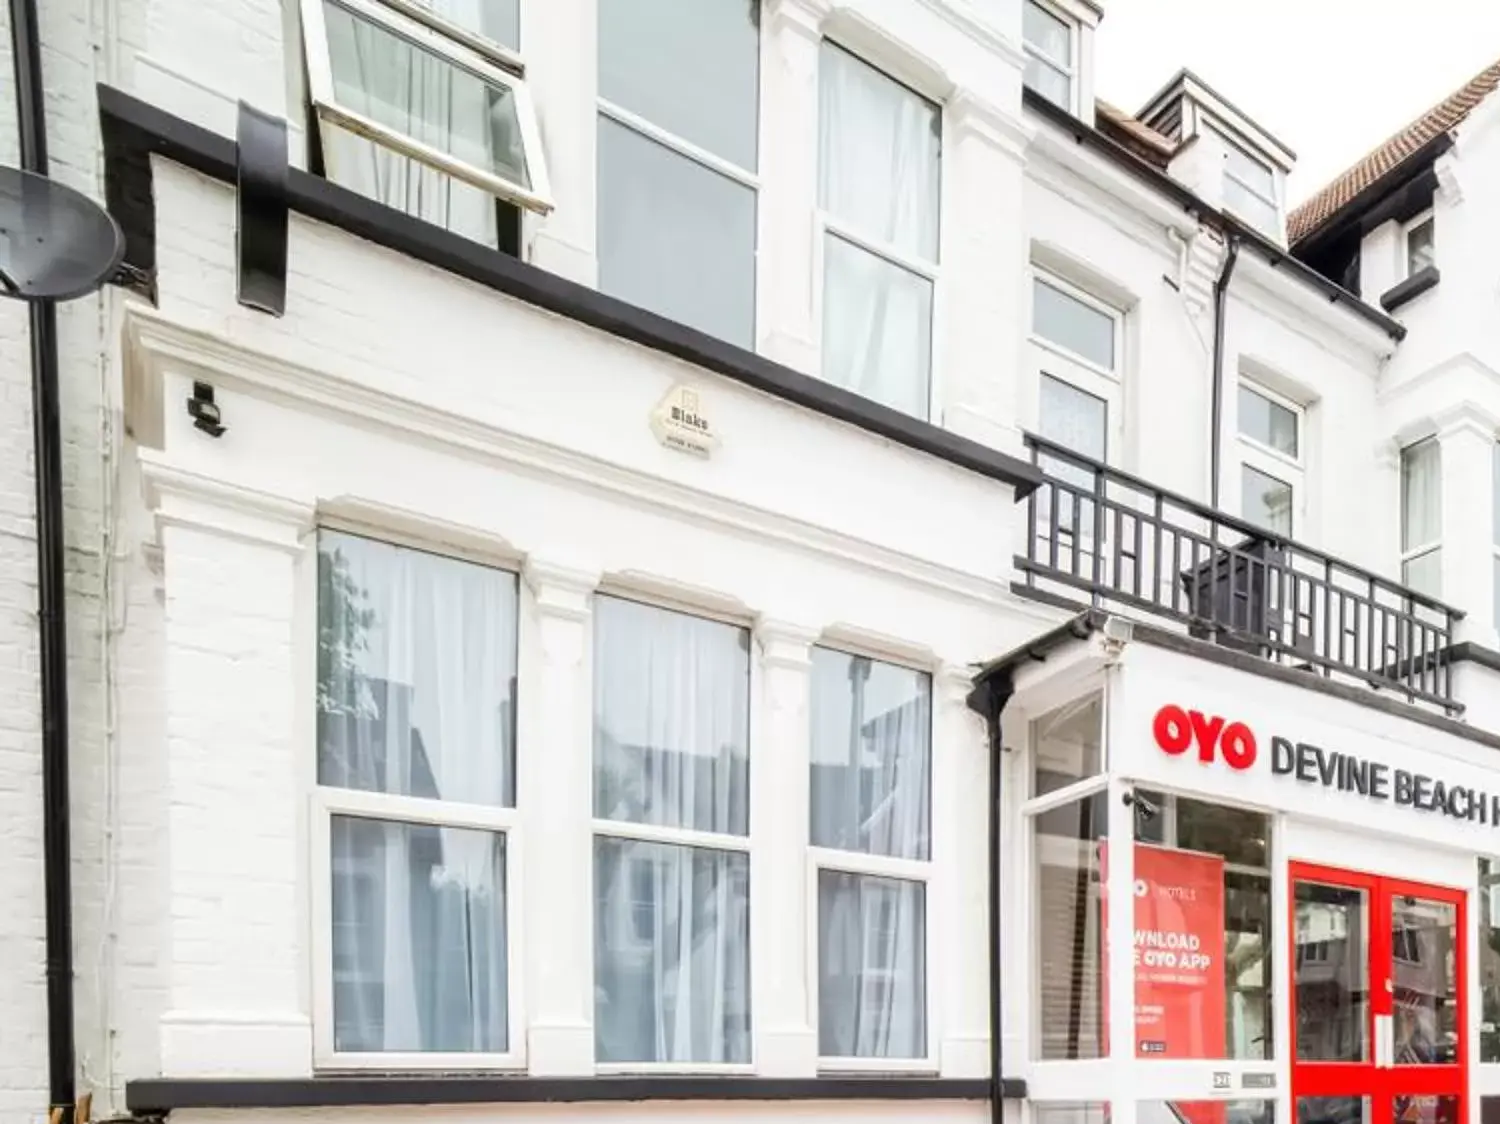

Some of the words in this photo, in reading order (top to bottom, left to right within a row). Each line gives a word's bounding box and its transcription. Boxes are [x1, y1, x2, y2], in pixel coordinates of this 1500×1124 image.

[1153, 704, 1257, 770] OYO
[1271, 735, 1389, 799] DEVINE
[1394, 768, 1487, 824] BEACH
[1134, 928, 1200, 950] WNLOAD
[1144, 951, 1177, 968] OYO
[1179, 954, 1212, 971] APP
